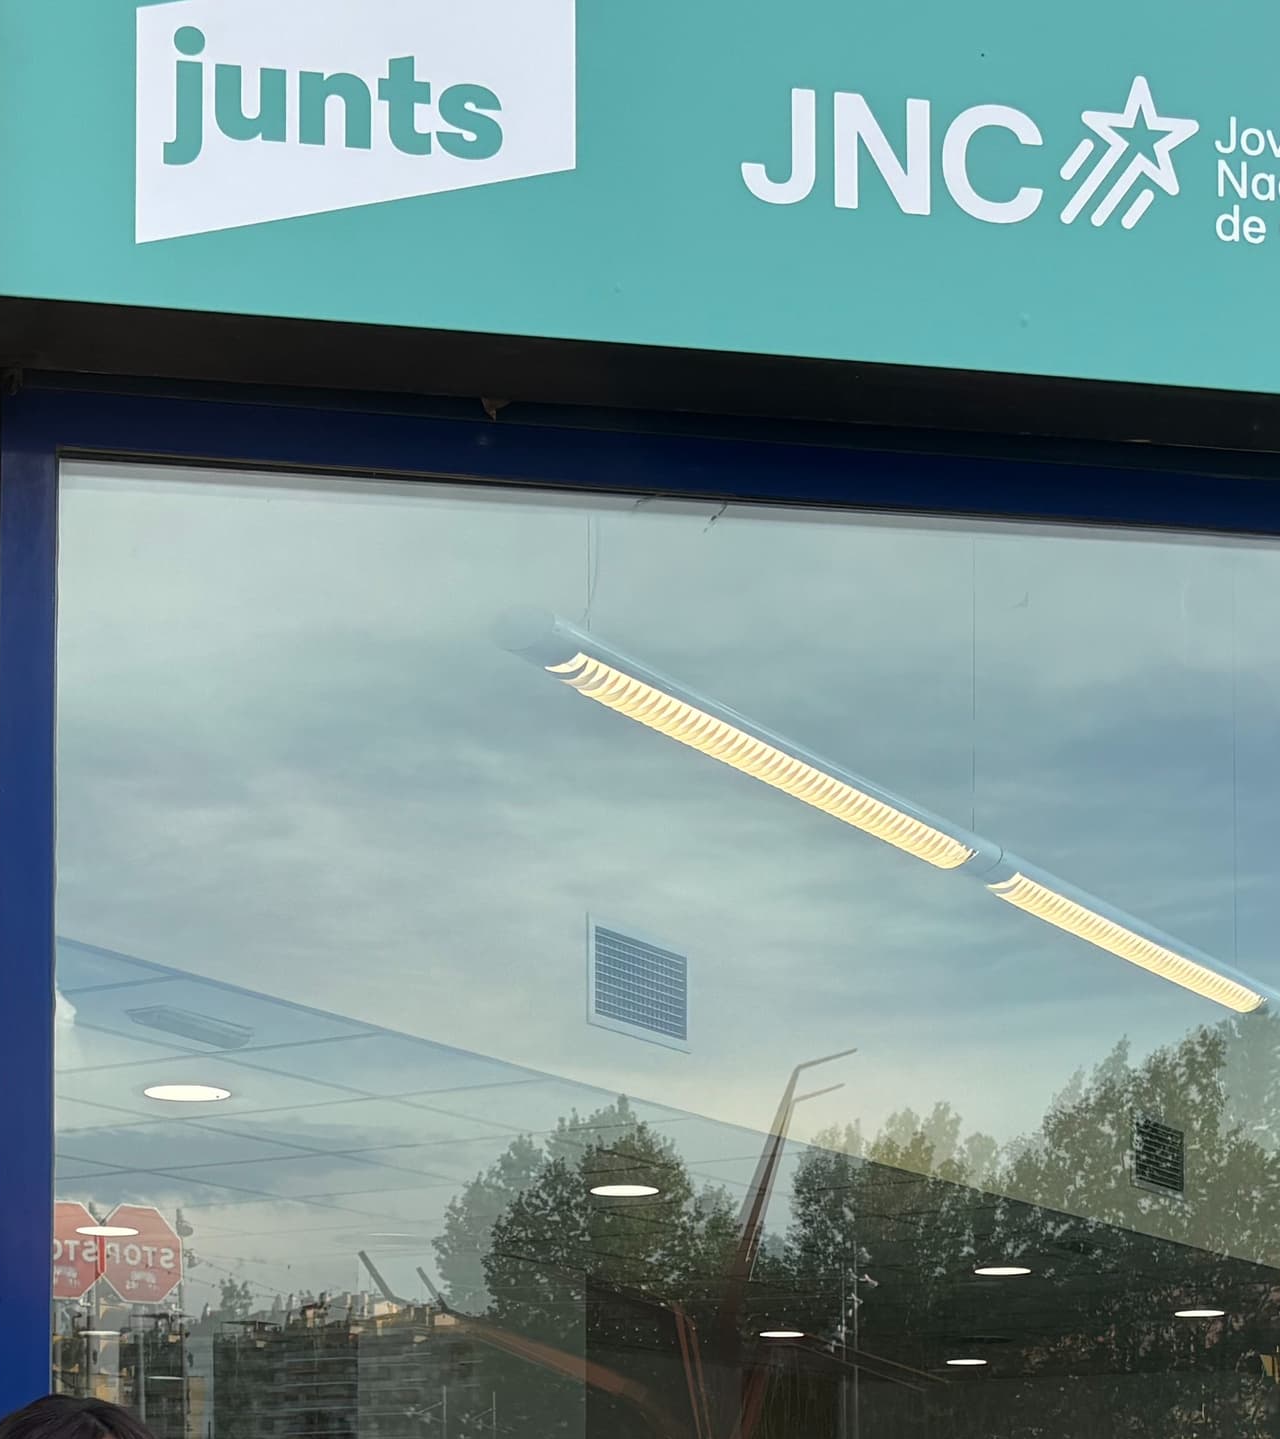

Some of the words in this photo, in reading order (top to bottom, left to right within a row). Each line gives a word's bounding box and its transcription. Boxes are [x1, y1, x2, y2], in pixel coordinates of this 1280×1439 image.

[163, 26, 504, 166] junts
[740, 87, 1044, 224] JNC
[1215, 204, 1267, 244] de
